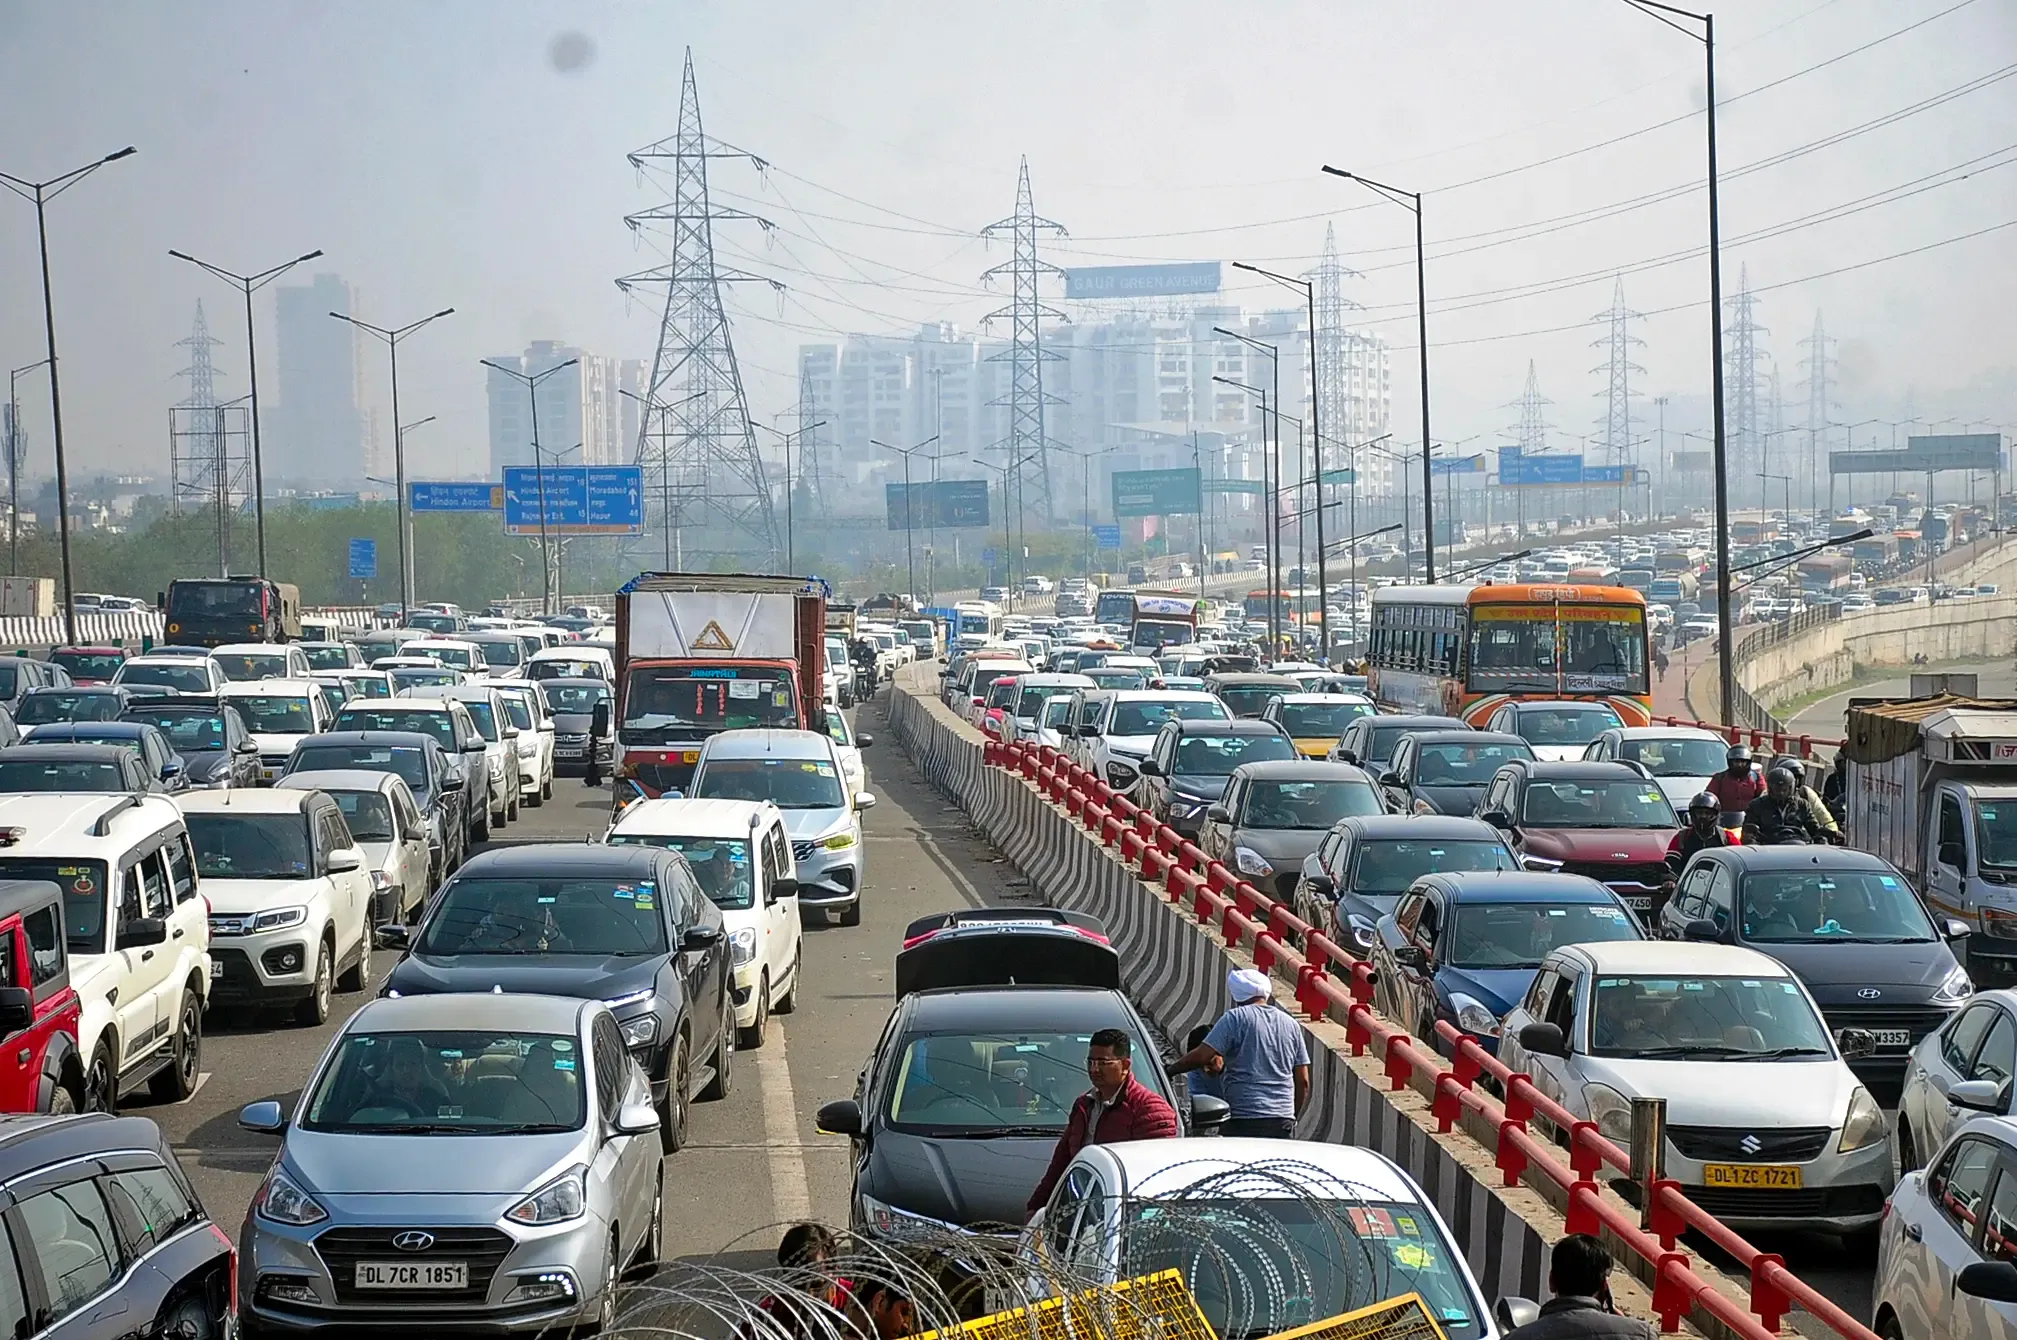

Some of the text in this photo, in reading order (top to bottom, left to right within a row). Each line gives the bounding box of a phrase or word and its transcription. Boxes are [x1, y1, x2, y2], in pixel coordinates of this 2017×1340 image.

[1075, 273, 1216, 290] GAUR GREEN AVENUE
[431, 498, 490, 507] Hindon Airport
[1764, 1170, 1796, 1185] 1721
[366, 1267, 385, 1283] DL
[389, 1267, 419, 1283] 7CR
[425, 1267, 462, 1283] 1851
